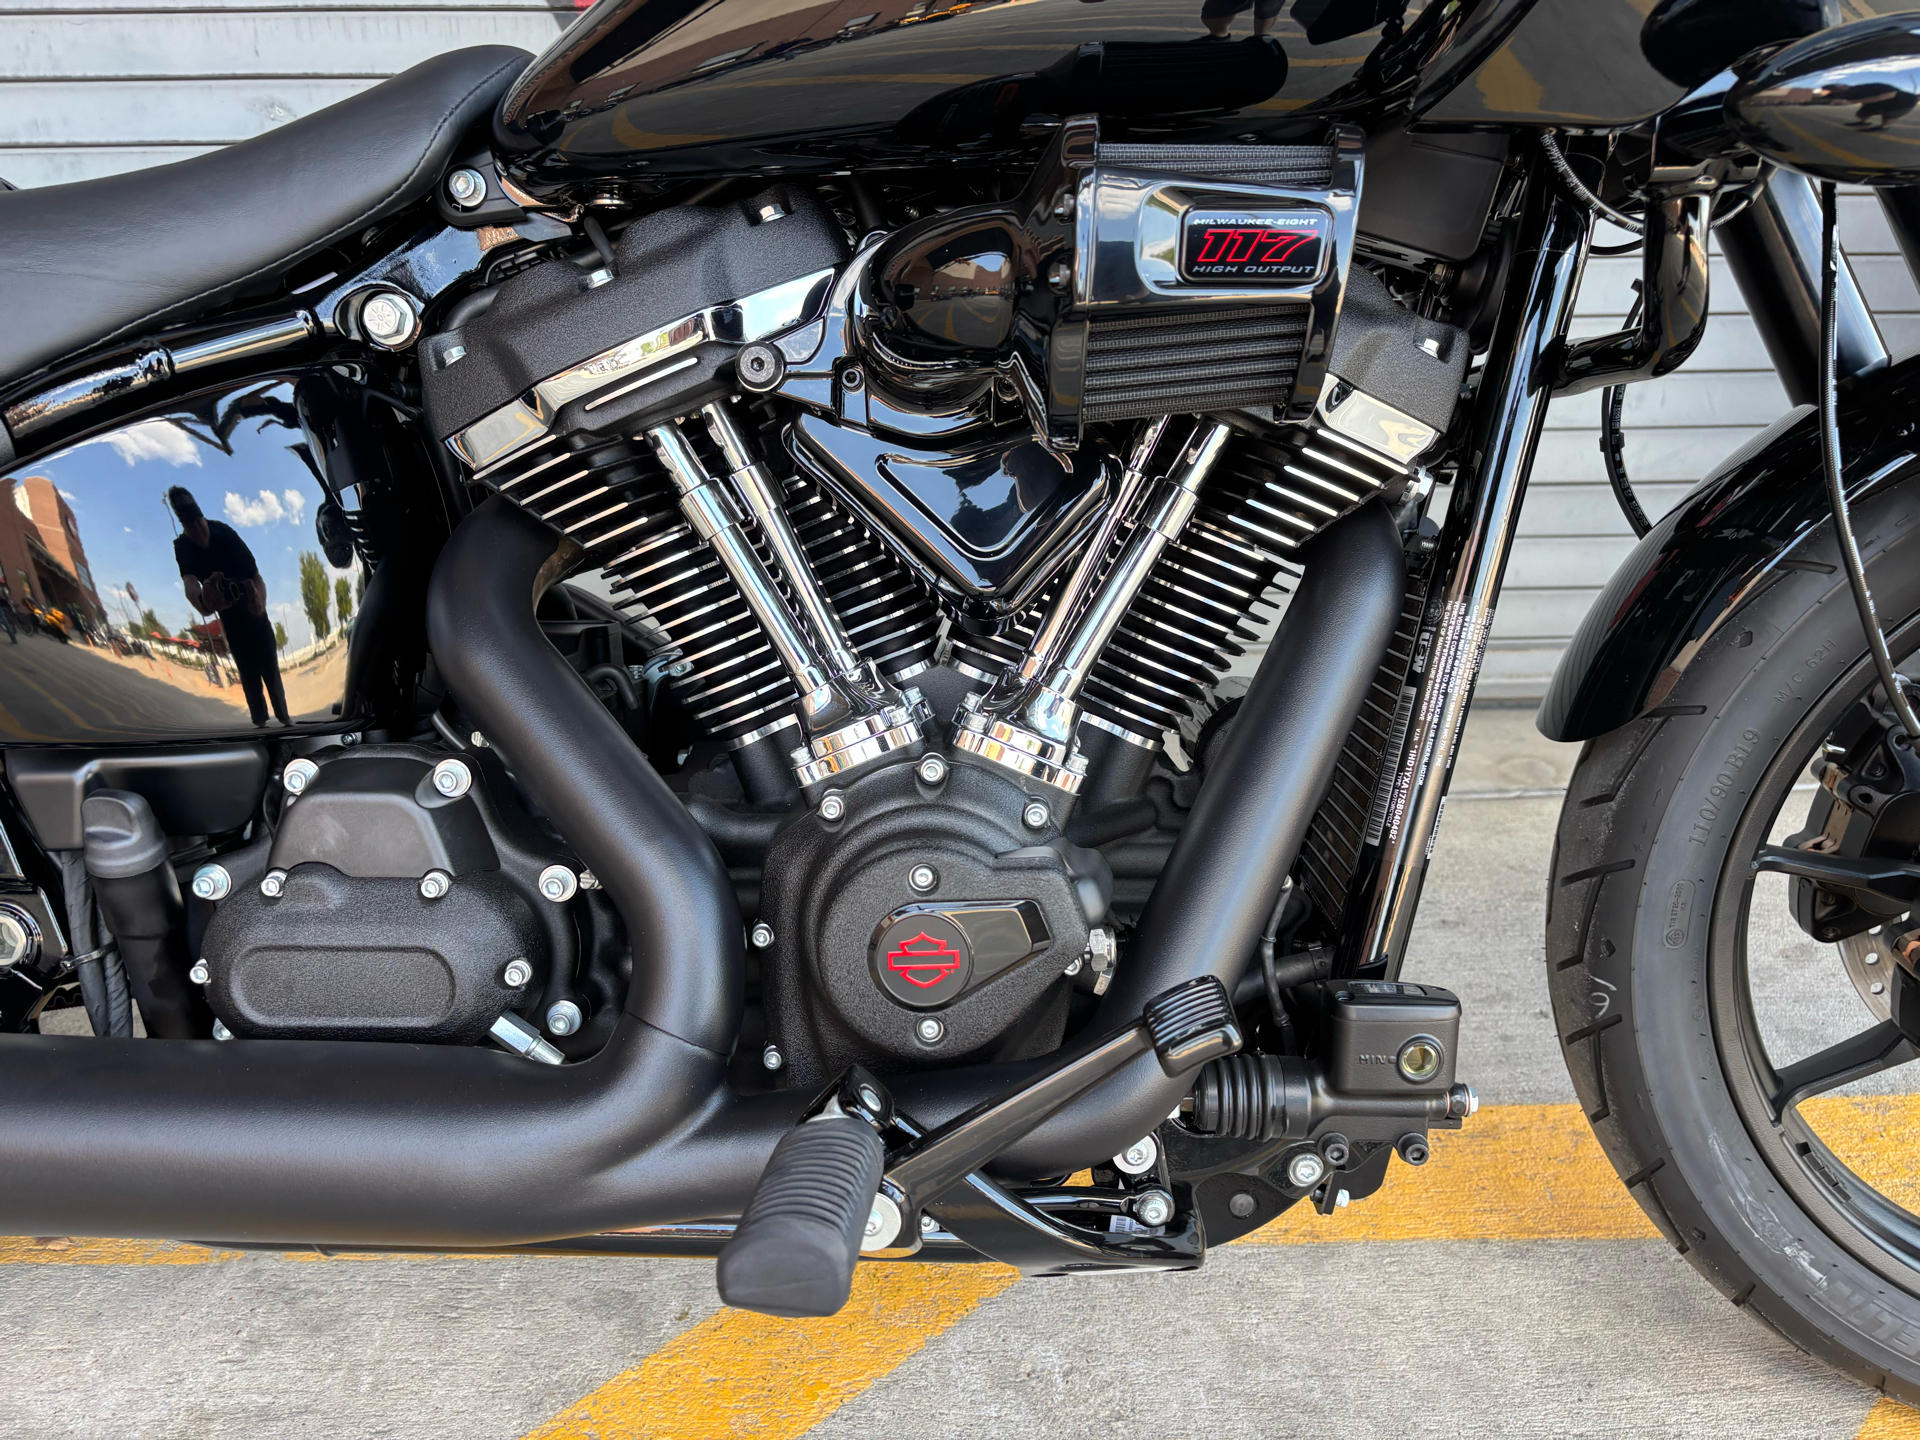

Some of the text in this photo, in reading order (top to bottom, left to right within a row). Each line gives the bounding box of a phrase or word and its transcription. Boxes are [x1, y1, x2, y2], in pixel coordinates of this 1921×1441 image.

[1197, 229, 1319, 262] 117
[1192, 265, 1315, 274] HIGH OUTPUT
[1441, 611, 1449, 627] DATE
[1449, 600, 1460, 625] VEHICLE
[1470, 605, 1479, 623] GAWR
[1439, 627, 1445, 636] OF
[1443, 625, 1454, 648] SAFETY
[1466, 624, 1474, 639] REAR
[1411, 630, 1430, 673] USW
[1428, 636, 1443, 679] MANUFACTURE
[1455, 650, 1461, 659] AT
[1460, 653, 1467, 662] KG
[1467, 653, 1473, 661] AT
[1435, 648, 1448, 683] STANDARDS
[1417, 602, 1466, 785] THIS VEHICLE CONFORMS TO ALL APPLICABLE US FEDERAL MOTOR
[1423, 679, 1433, 701] SHOWN
[1447, 676, 1455, 693] COLD
[1451, 685, 1459, 701] WITH
[1428, 689, 1438, 712] EFFECT
[1418, 700, 1428, 721] ABOVE
[1425, 712, 1433, 721] ON
[1688, 639, 1836, 848] 110/90 B19 M/C 62H
[1435, 753, 1443, 767] TIRE
[1385, 771, 1403, 827] TYPE: MOTORCYCLE
[1358, 1054, 1386, 1065] MIN
